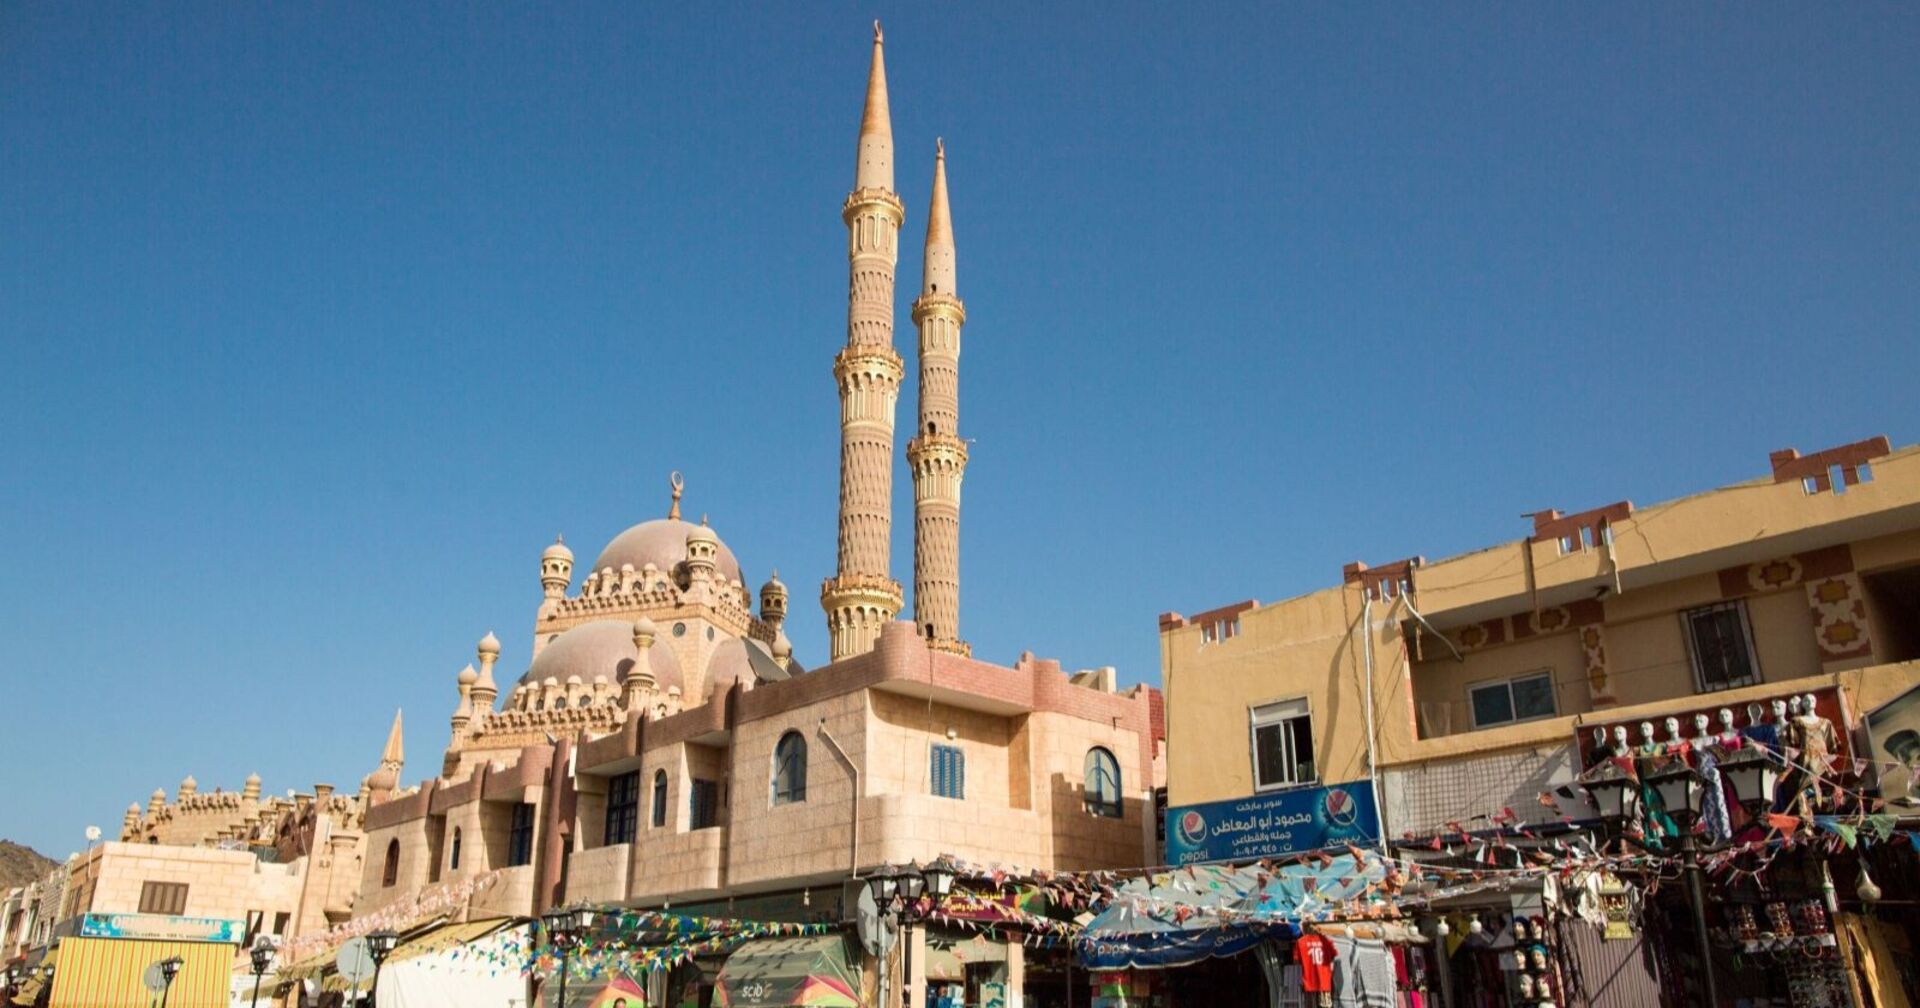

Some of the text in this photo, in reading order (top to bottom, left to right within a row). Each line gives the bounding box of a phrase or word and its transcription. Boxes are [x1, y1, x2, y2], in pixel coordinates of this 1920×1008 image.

[1236, 799, 1283, 812] سوبر ماركت
[1258, 811, 1273, 830] أبو
[1275, 812, 1312, 827] محمود
[1179, 849, 1209, 865] pepsi
[1308, 946, 1324, 966] 10
